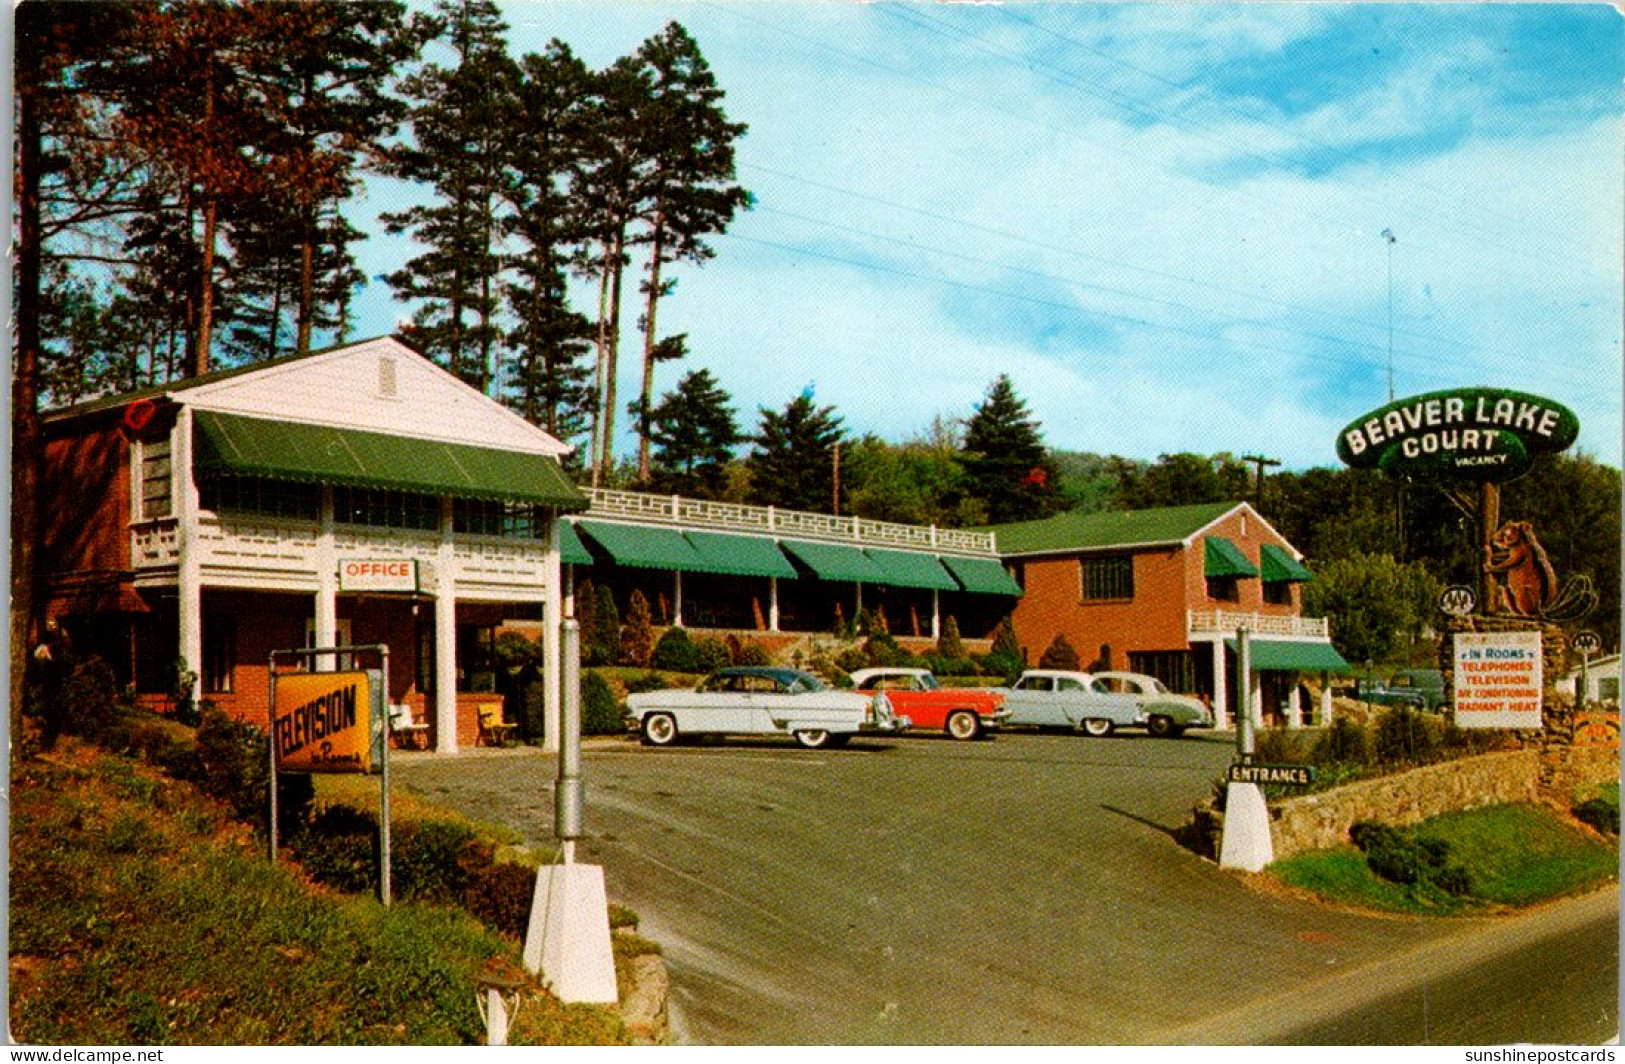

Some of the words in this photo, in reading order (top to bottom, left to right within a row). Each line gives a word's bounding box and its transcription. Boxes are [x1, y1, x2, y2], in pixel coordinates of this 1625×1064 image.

[1346, 398, 1464, 455] BEAVER
[1476, 396, 1560, 438] LAKE
[1402, 429, 1499, 458] COURT
[1454, 454, 1508, 468] VACANCY
[346, 563, 409, 576] OFFICE
[1460, 662, 1533, 671] TELEPHONES
[1464, 676, 1530, 685] TELEVISION
[1476, 689, 1539, 698] CONDITIONING
[1457, 702, 1504, 711] RADIANT
[1508, 702, 1538, 711] HEAT
[273, 683, 357, 768] TELEVISION
[1233, 767, 1307, 783] ENTRANCE
